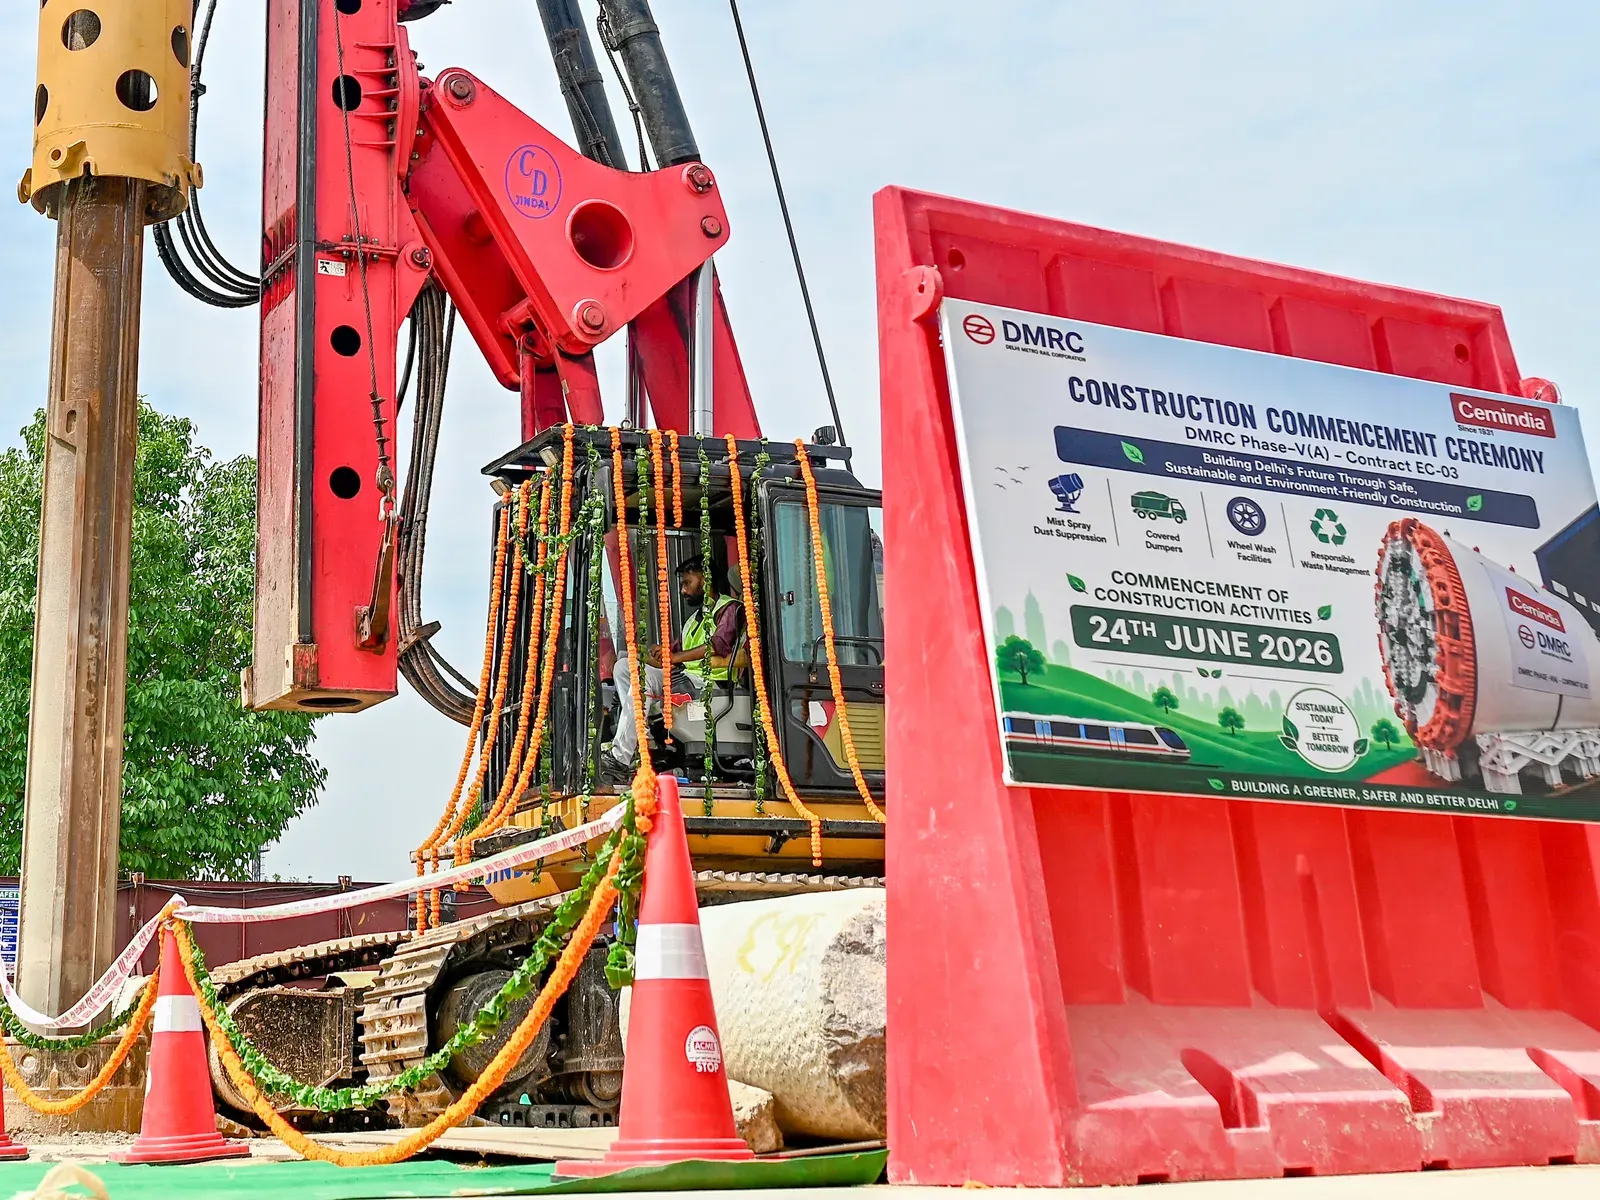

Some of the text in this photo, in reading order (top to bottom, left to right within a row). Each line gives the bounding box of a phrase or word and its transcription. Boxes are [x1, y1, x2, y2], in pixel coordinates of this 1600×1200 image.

[516, 195, 549, 210] JINDAL
[1002, 320, 1084, 353] DMRC
[1051, 352, 1086, 362] CORPORATION
[1458, 401, 1546, 431] Cemindia
[1068, 376, 1544, 474] CONSTRUCTION COMMENCEMENT CEREMONY
[1458, 425, 1494, 436] Since 1931
[1185, 426, 1236, 446] DMRC
[1346, 451, 1411, 473] Contract
[1417, 462, 1459, 480] EC-03
[1203, 453, 1252, 471] Building
[1297, 467, 1335, 482] Future
[1338, 472, 1386, 490] Through
[1389, 480, 1417, 495] Safe,
[1165, 461, 1461, 513] Sustainable and Environment-Friendly Construction
[1047, 516, 1091, 532] Mist Spray
[1034, 526, 1107, 544] Dust Suppression
[1146, 531, 1180, 542] Covered
[1146, 541, 1183, 553] Dumpers
[1227, 540, 1277, 555] Wheel Wash
[1238, 552, 1272, 565] Facilities
[1311, 551, 1355, 565] Responsible
[1301, 560, 1371, 577] Waste Management
[1111, 570, 1289, 604] COMMENCEMENT OF
[1094, 587, 1312, 625] CONSTRUCTION ACTIVITIES
[1088, 614, 1334, 667] 24TH JUNE 2026
[1536, 631, 1571, 657] DMRC
[1295, 702, 1345, 715] SUSTAINABLE
[1310, 713, 1334, 725] TODAY
[1312, 732, 1340, 743] BETTER
[1306, 741, 1349, 754] TOMORROW
[1231, 780, 1499, 810] BUILDING A GREENER, SAFER AND BETTER DELHI
[695, 1042, 714, 1050] ACME
[696, 1062, 719, 1072] STOP
